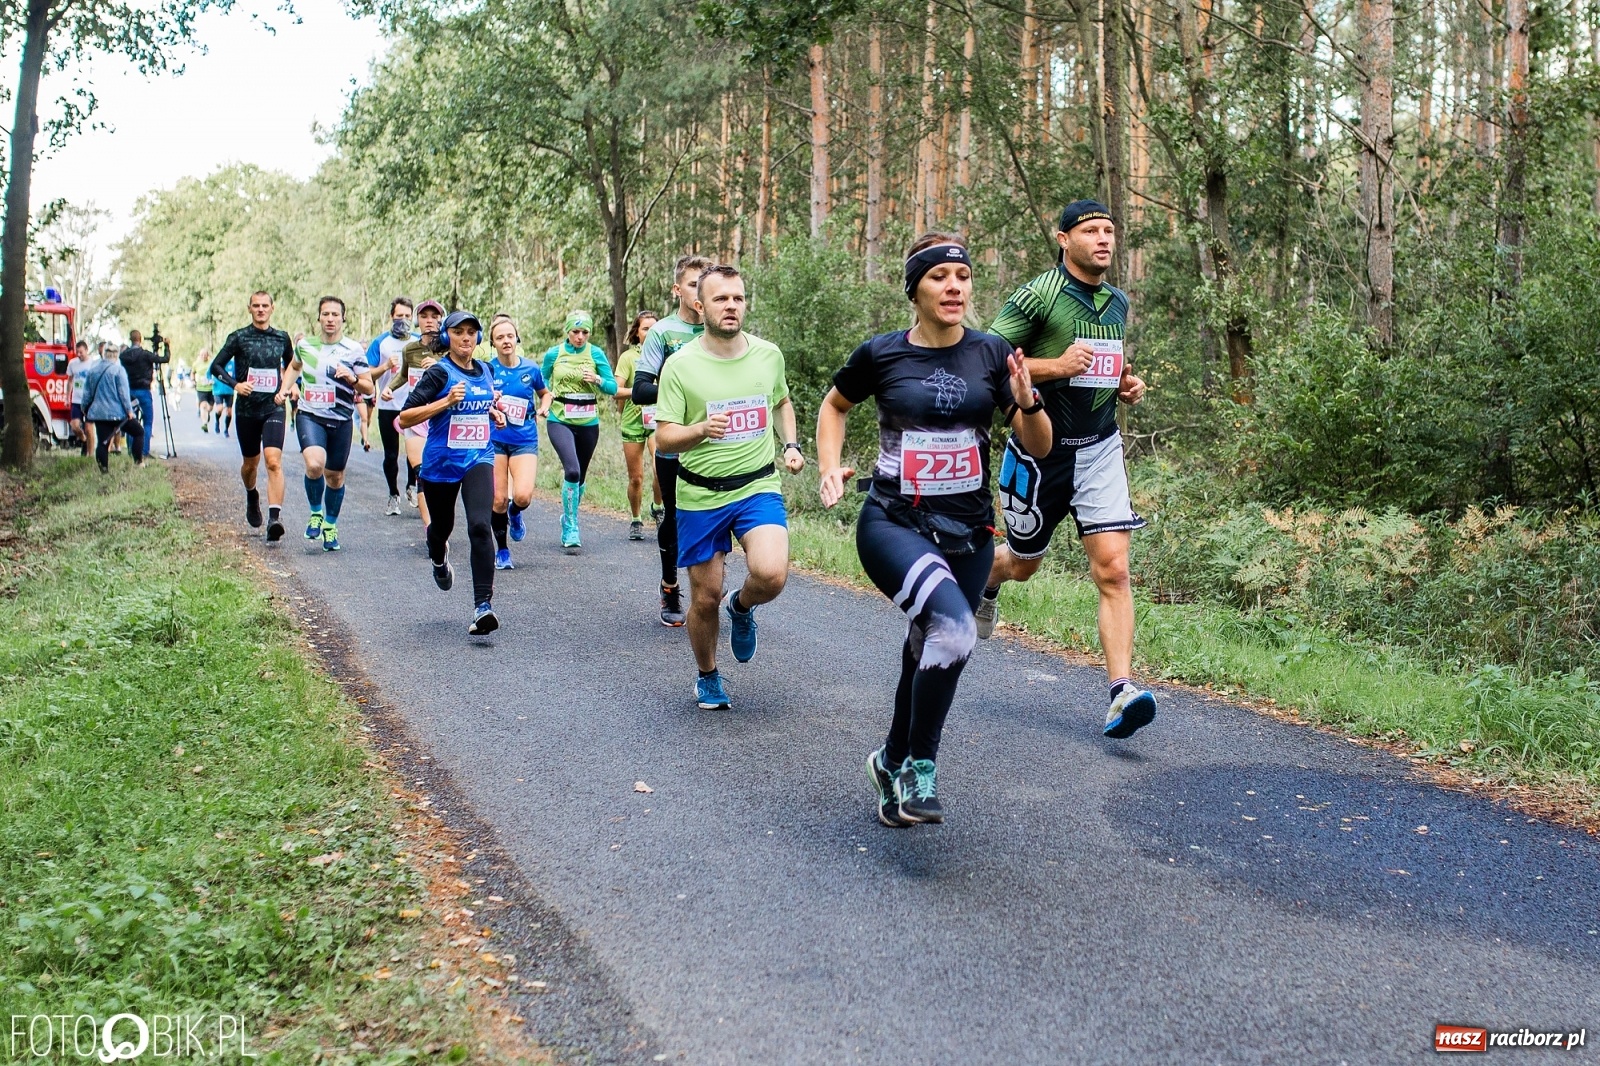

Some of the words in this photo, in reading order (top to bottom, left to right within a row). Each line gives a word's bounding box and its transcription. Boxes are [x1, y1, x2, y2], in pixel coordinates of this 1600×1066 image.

[252, 376, 274, 386] 230
[309, 391, 329, 402] 221
[501, 403, 523, 418] 209
[456, 425, 485, 440] 228
[915, 451, 972, 480] 225
